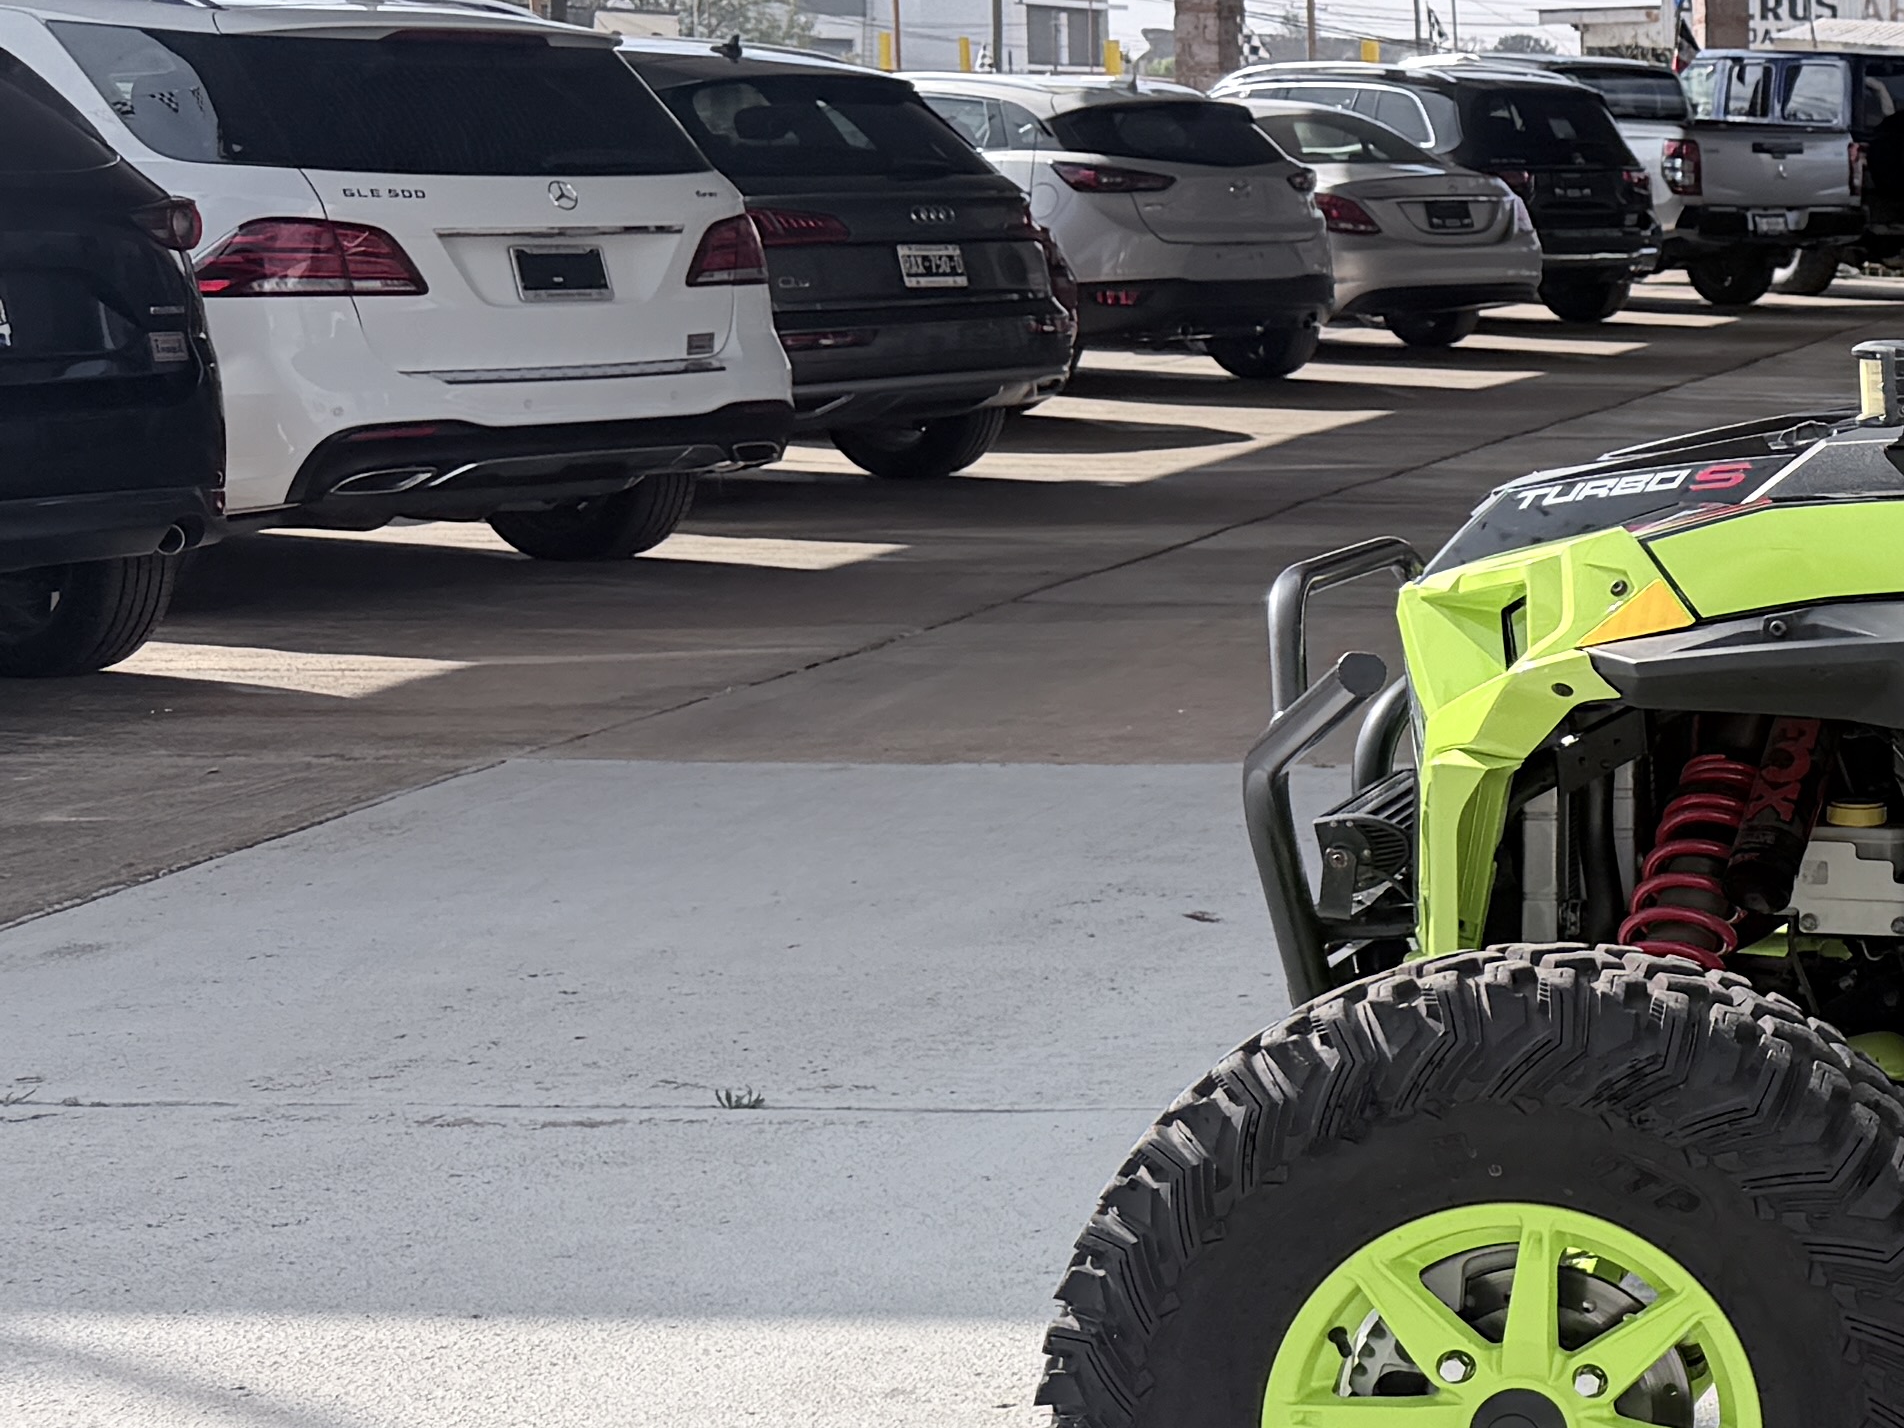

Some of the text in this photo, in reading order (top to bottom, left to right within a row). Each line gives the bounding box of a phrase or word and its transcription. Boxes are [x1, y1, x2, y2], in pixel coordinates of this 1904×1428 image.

[341, 187, 427, 200] GLE 500
[1516, 461, 1754, 511] TURBO S
[1745, 717, 1821, 823] FOX
